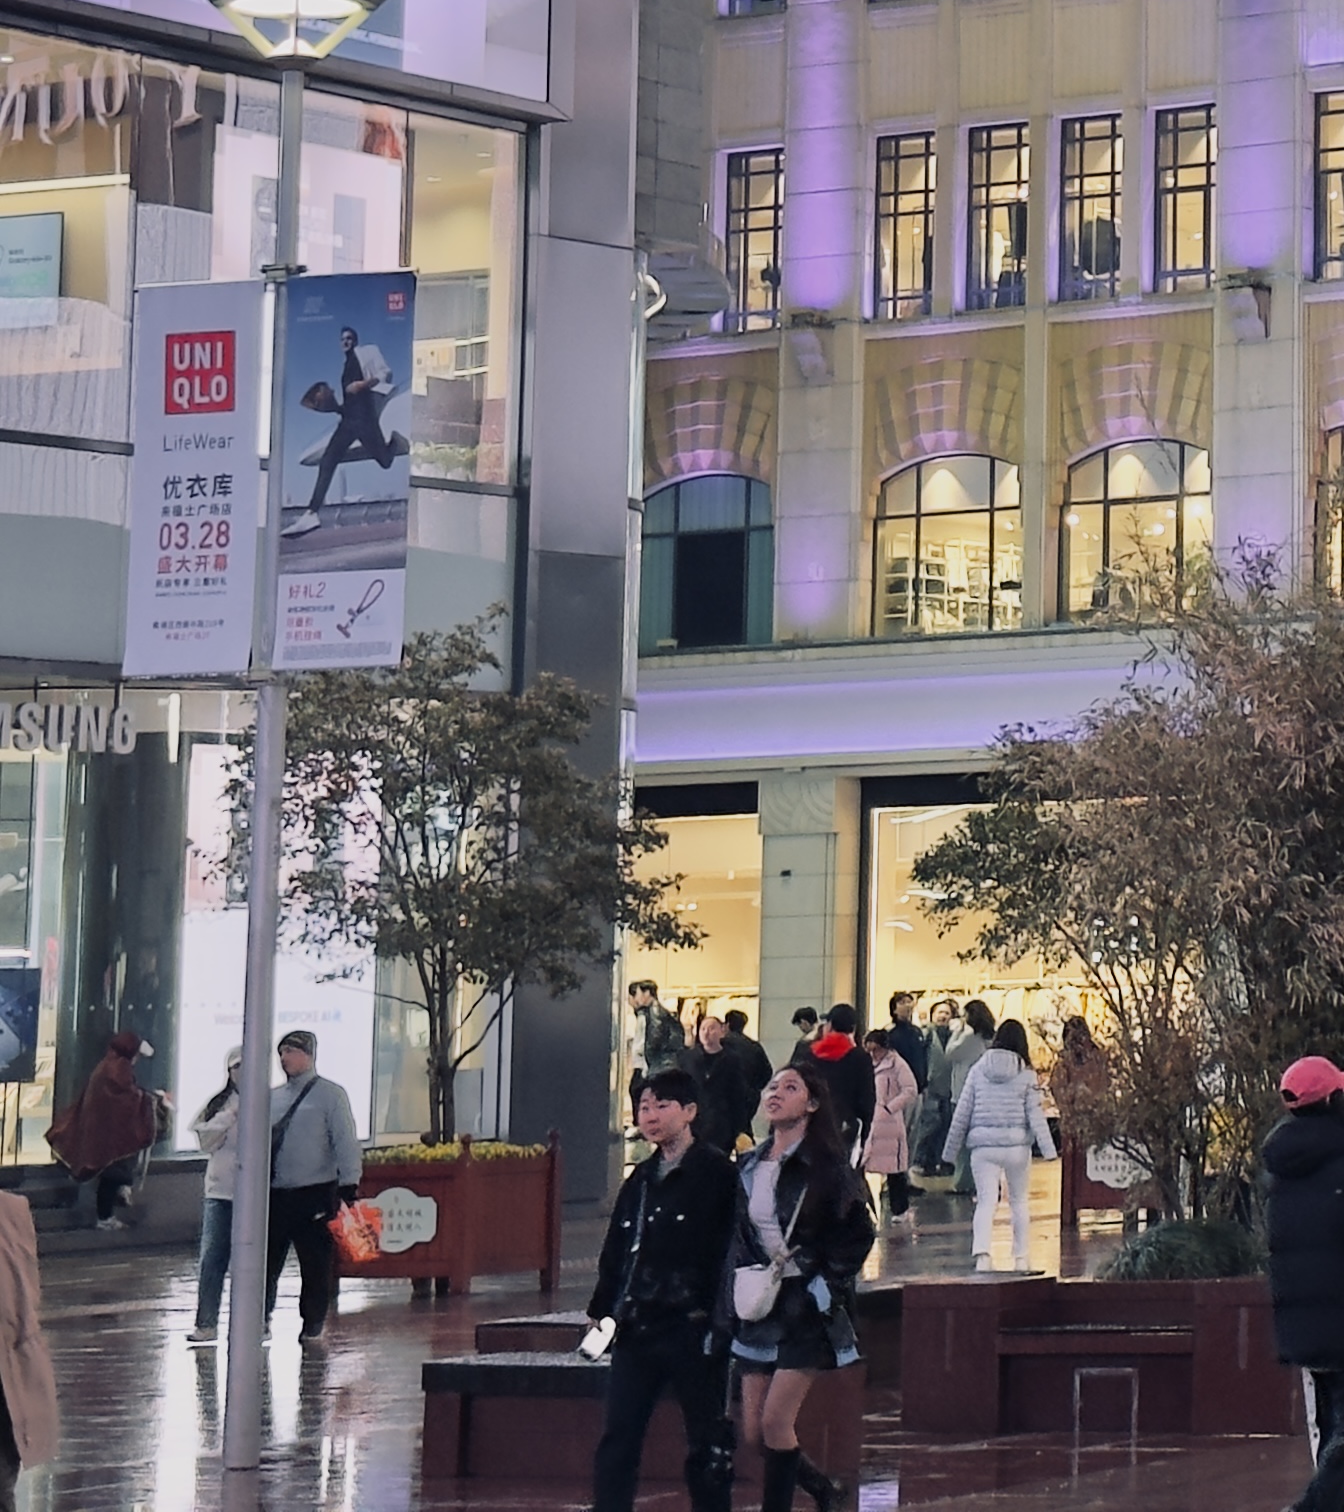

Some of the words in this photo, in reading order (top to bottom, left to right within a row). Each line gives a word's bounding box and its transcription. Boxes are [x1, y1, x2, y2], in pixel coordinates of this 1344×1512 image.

[173, 341, 223, 371] UNI
[173, 375, 228, 409] QLO
[163, 432, 234, 452] LifeWear
[163, 473, 233, 500] 优衣库
[159, 520, 230, 551] 03.28
[0, 702, 136, 754] SUNG
